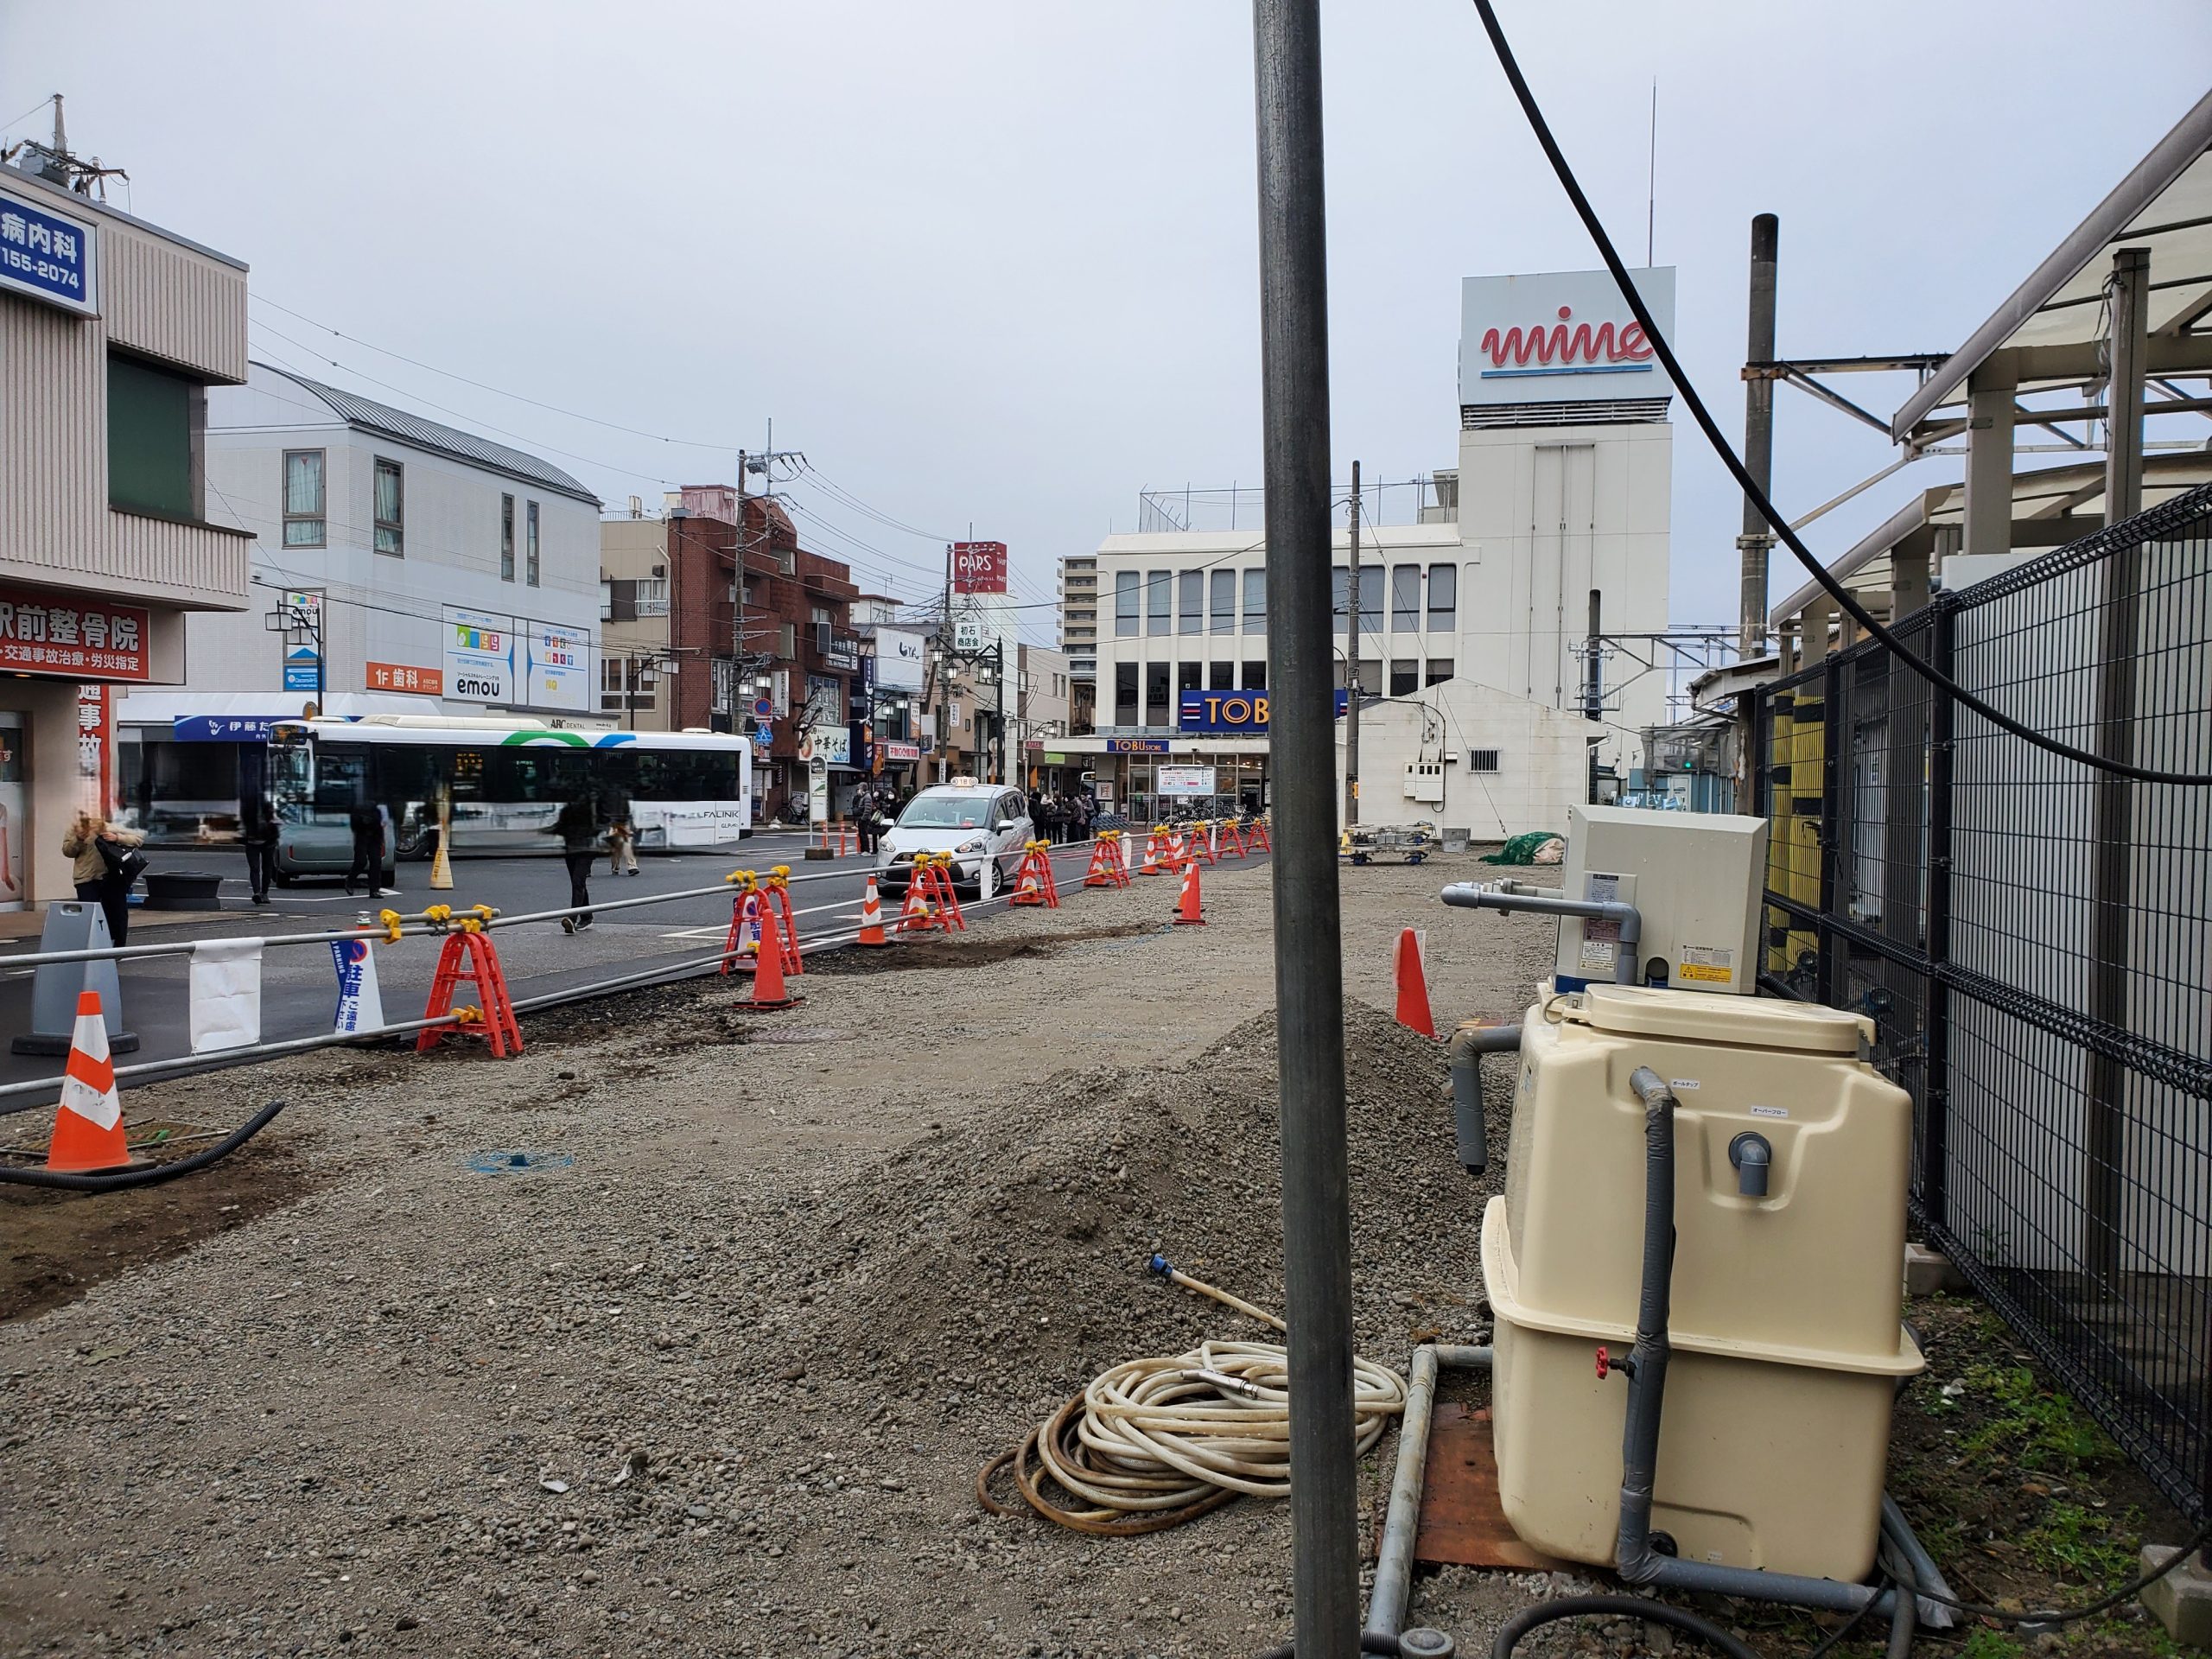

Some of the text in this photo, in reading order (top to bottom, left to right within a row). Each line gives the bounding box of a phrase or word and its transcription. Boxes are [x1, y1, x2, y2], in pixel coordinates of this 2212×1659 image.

[2, 213, 78, 264] 病内科
[1480, 306, 1654, 365] mine
[959, 555, 992, 572] PARS
[961, 626, 976, 635] 初石
[957, 638, 979, 647] 商店会
[392, 667, 418, 689] 歯科
[457, 678, 499, 696] emou
[814, 735, 848, 753] 中華そば
[1114, 741, 1146, 751] TOBU
